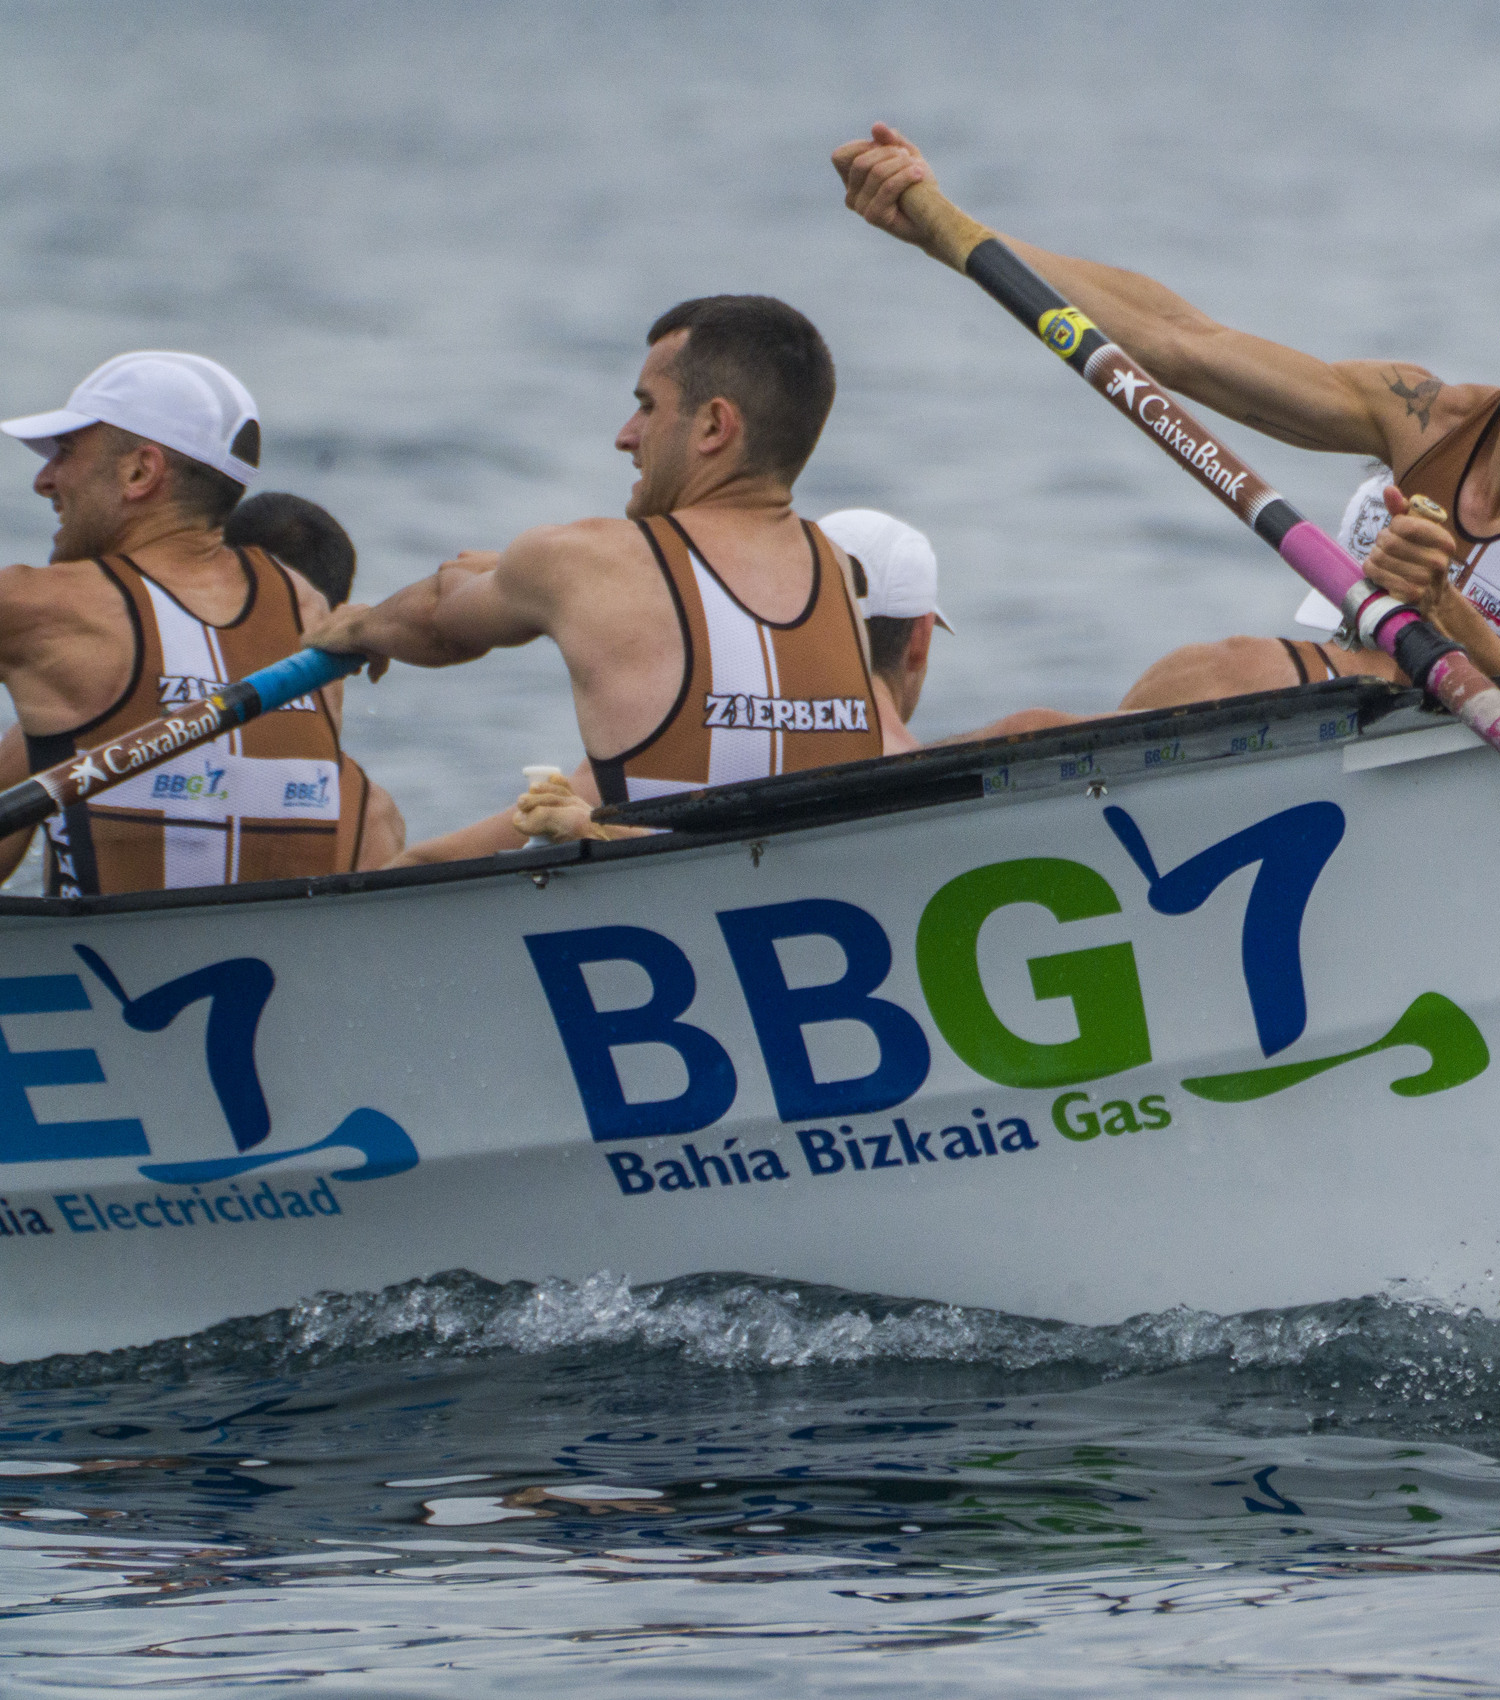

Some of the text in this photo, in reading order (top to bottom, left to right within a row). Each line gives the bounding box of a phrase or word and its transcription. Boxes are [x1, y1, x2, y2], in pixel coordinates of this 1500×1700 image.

[1138, 395, 1249, 501] CaixaBank
[604, 1091, 1172, 1196] Bahía Bizkaia Gas
[53, 1176, 343, 1234] Electricidad
